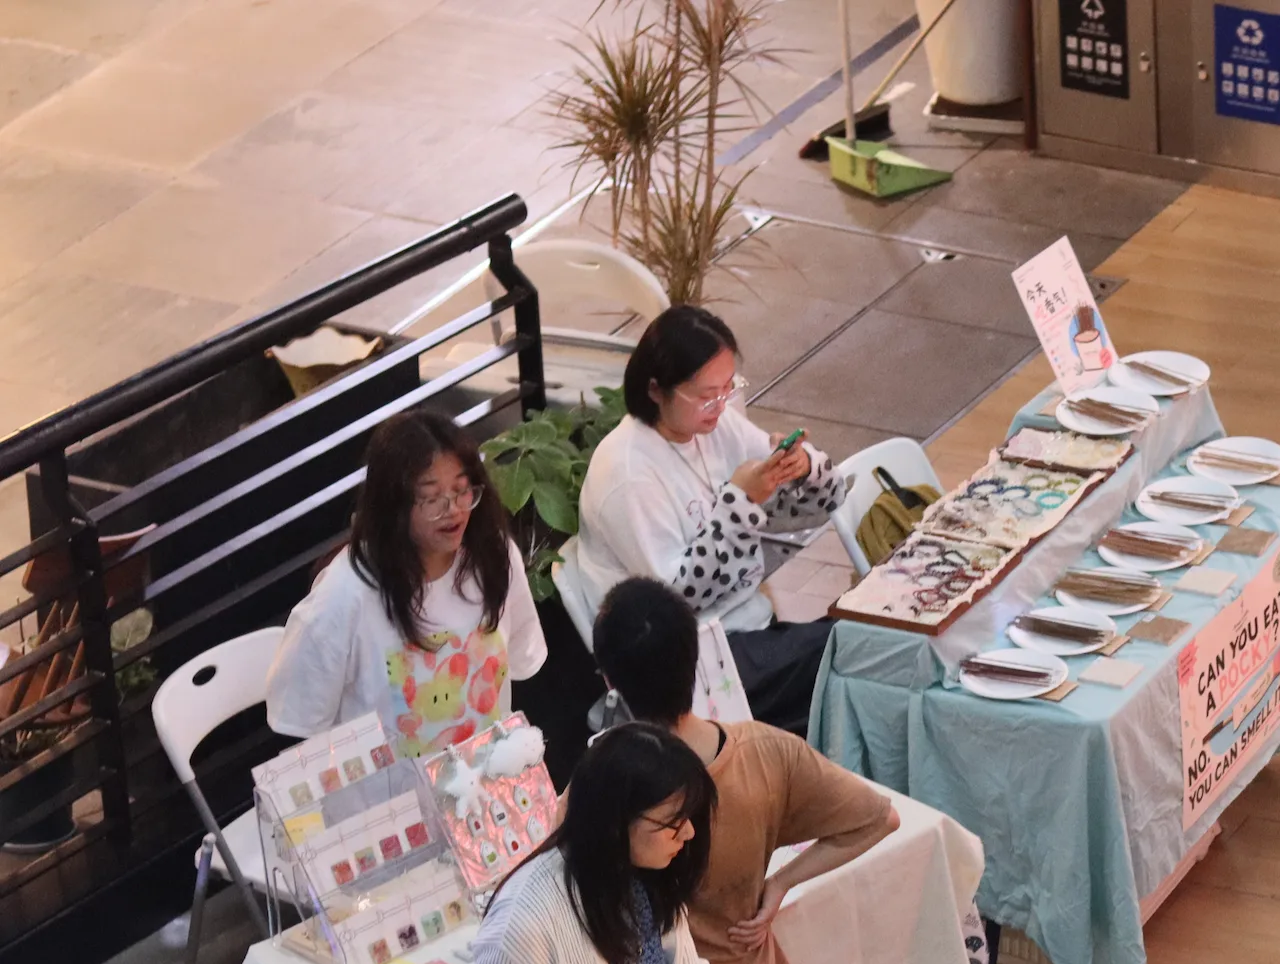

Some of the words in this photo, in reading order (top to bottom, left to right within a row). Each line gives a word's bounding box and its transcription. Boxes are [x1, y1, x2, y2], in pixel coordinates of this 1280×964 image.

[1026, 281, 1047, 303] 今天
[1198, 649, 1225, 696] CAN
[1230, 616, 1259, 659] YOU
[1206, 691, 1217, 718] A
[1187, 750, 1211, 787] NO.
[1188, 774, 1213, 811] YOU
[1214, 742, 1238, 782] CAN
[1240, 699, 1272, 751] SMELL
